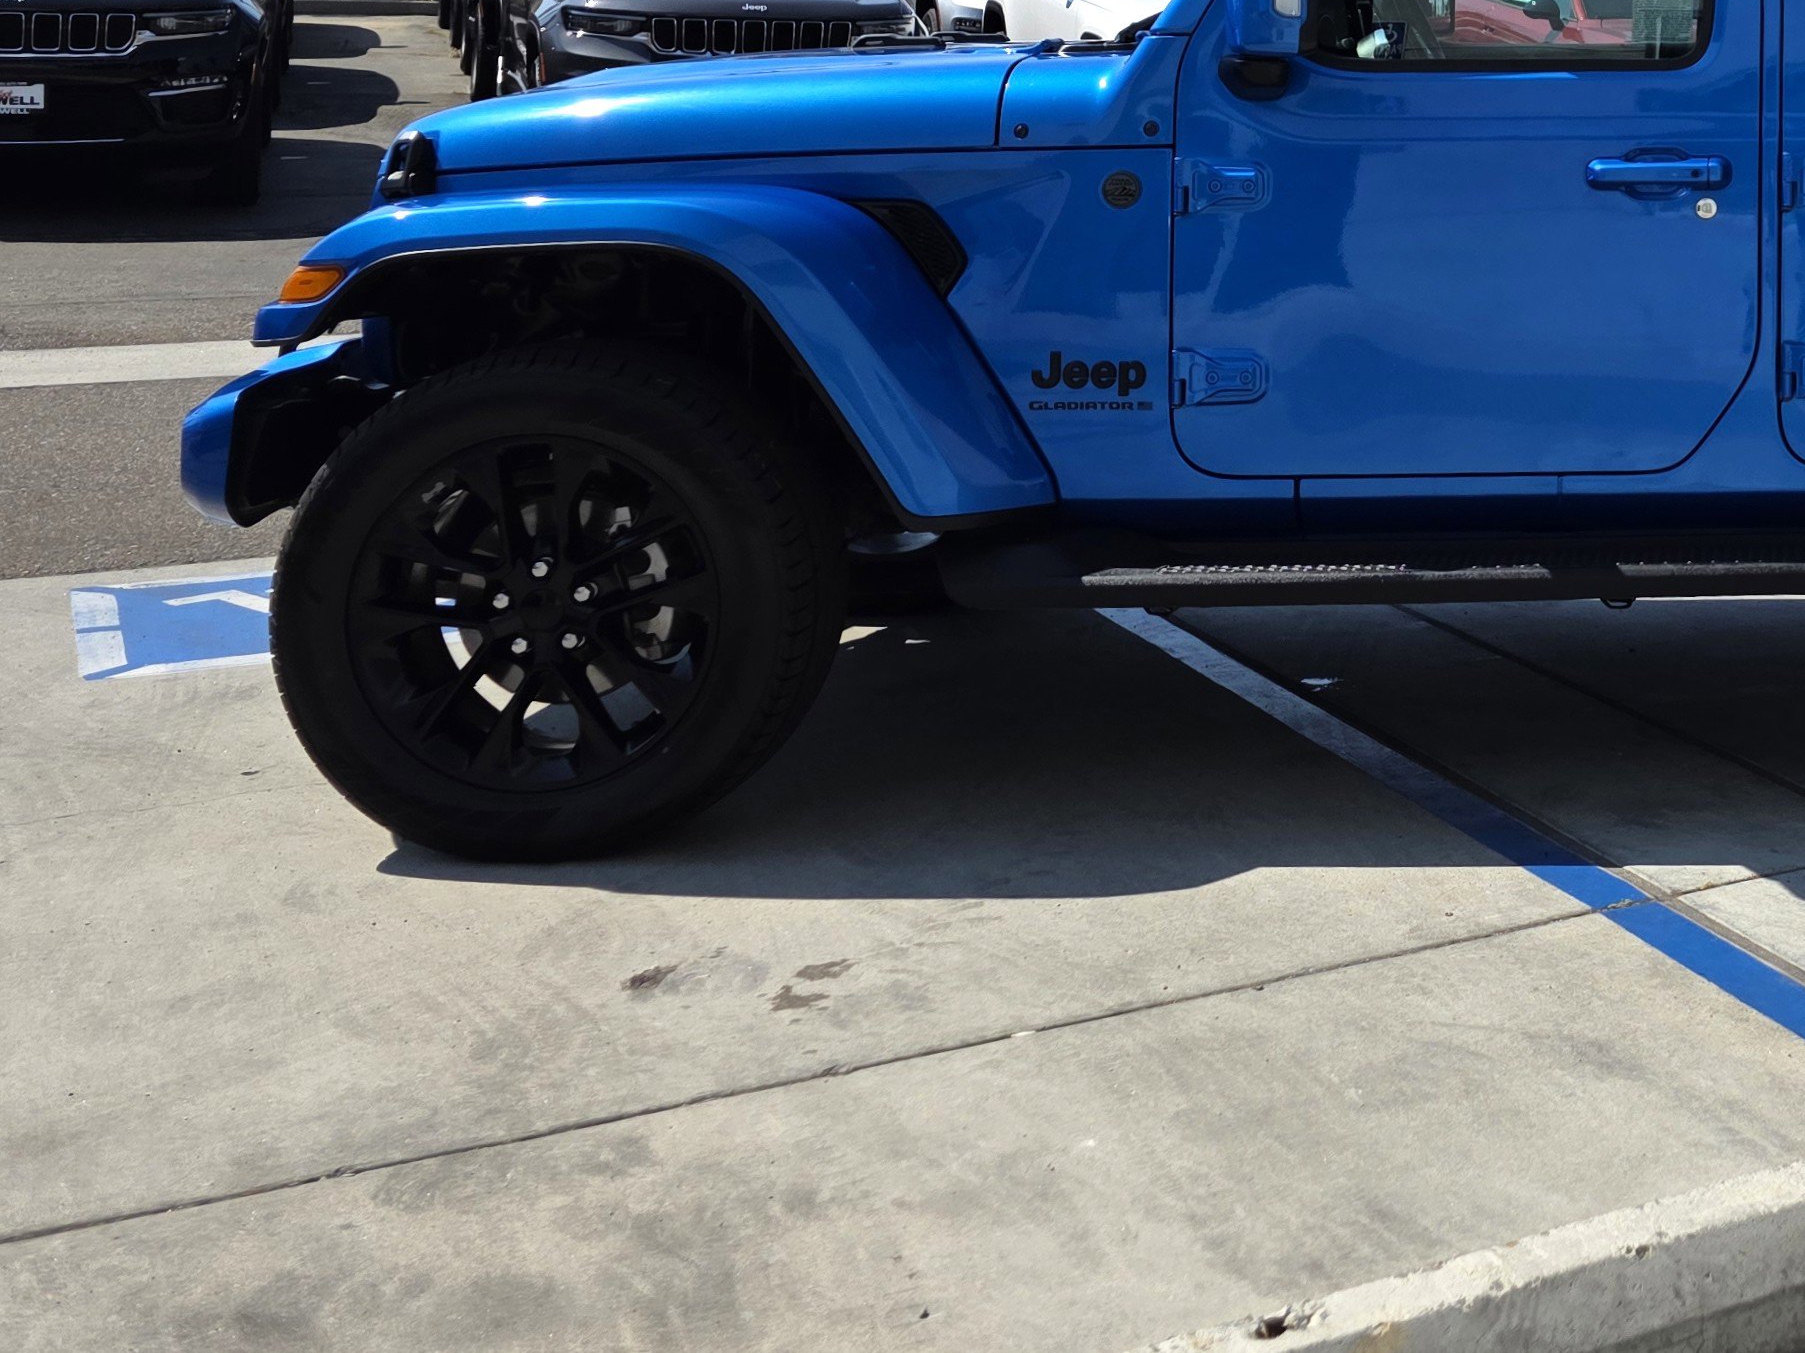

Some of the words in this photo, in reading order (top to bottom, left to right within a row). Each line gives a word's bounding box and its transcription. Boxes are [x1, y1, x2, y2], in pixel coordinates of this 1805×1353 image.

[741, 3, 768, 12] Jeep
[1031, 350, 1147, 397] Jeep
[1028, 400, 1134, 411] GLADIATOR
